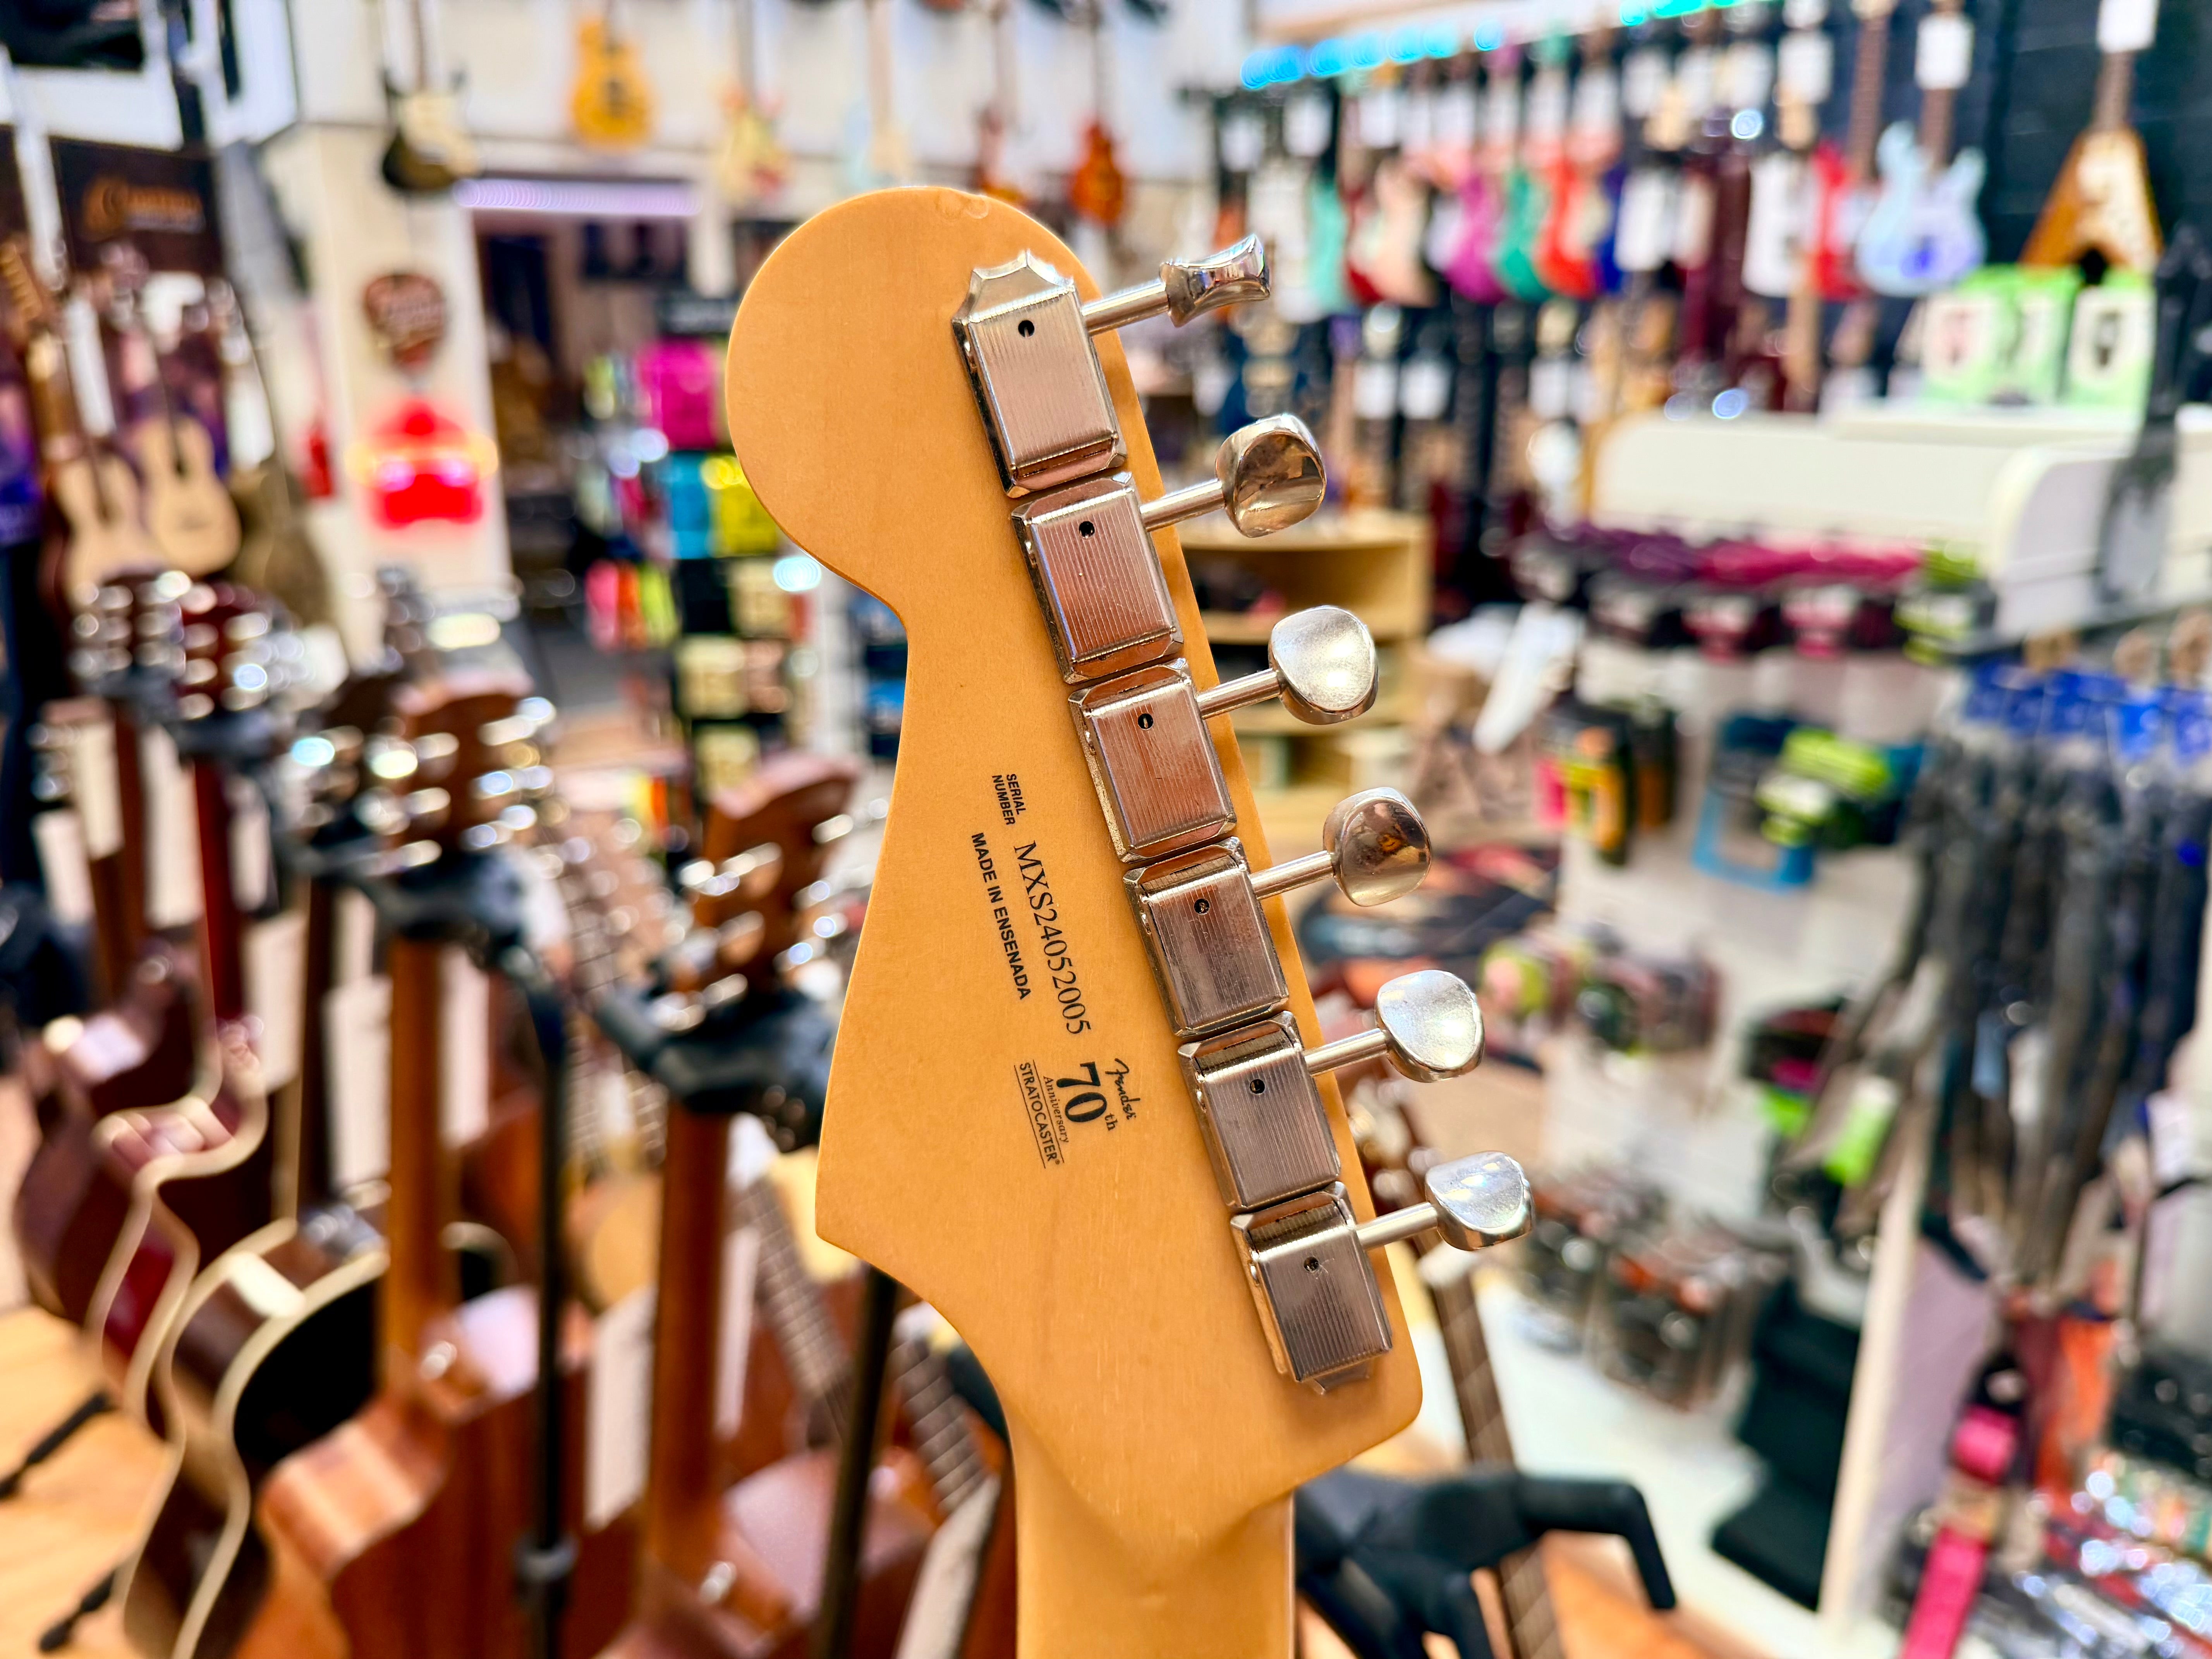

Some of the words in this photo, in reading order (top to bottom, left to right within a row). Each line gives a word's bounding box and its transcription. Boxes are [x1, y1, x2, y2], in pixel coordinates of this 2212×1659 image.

[991, 775, 1016, 825] NUMBER
[1006, 773, 1026, 815] SERIAL
[971, 832, 998, 883] MADE
[987, 885, 1003, 903] IN
[993, 906, 1031, 1000] ENSENADA
[1013, 840, 1092, 1034] MXS24052005
[1042, 1075, 1069, 1143] Anniversary
[1105, 1058, 1141, 1120] Fender
